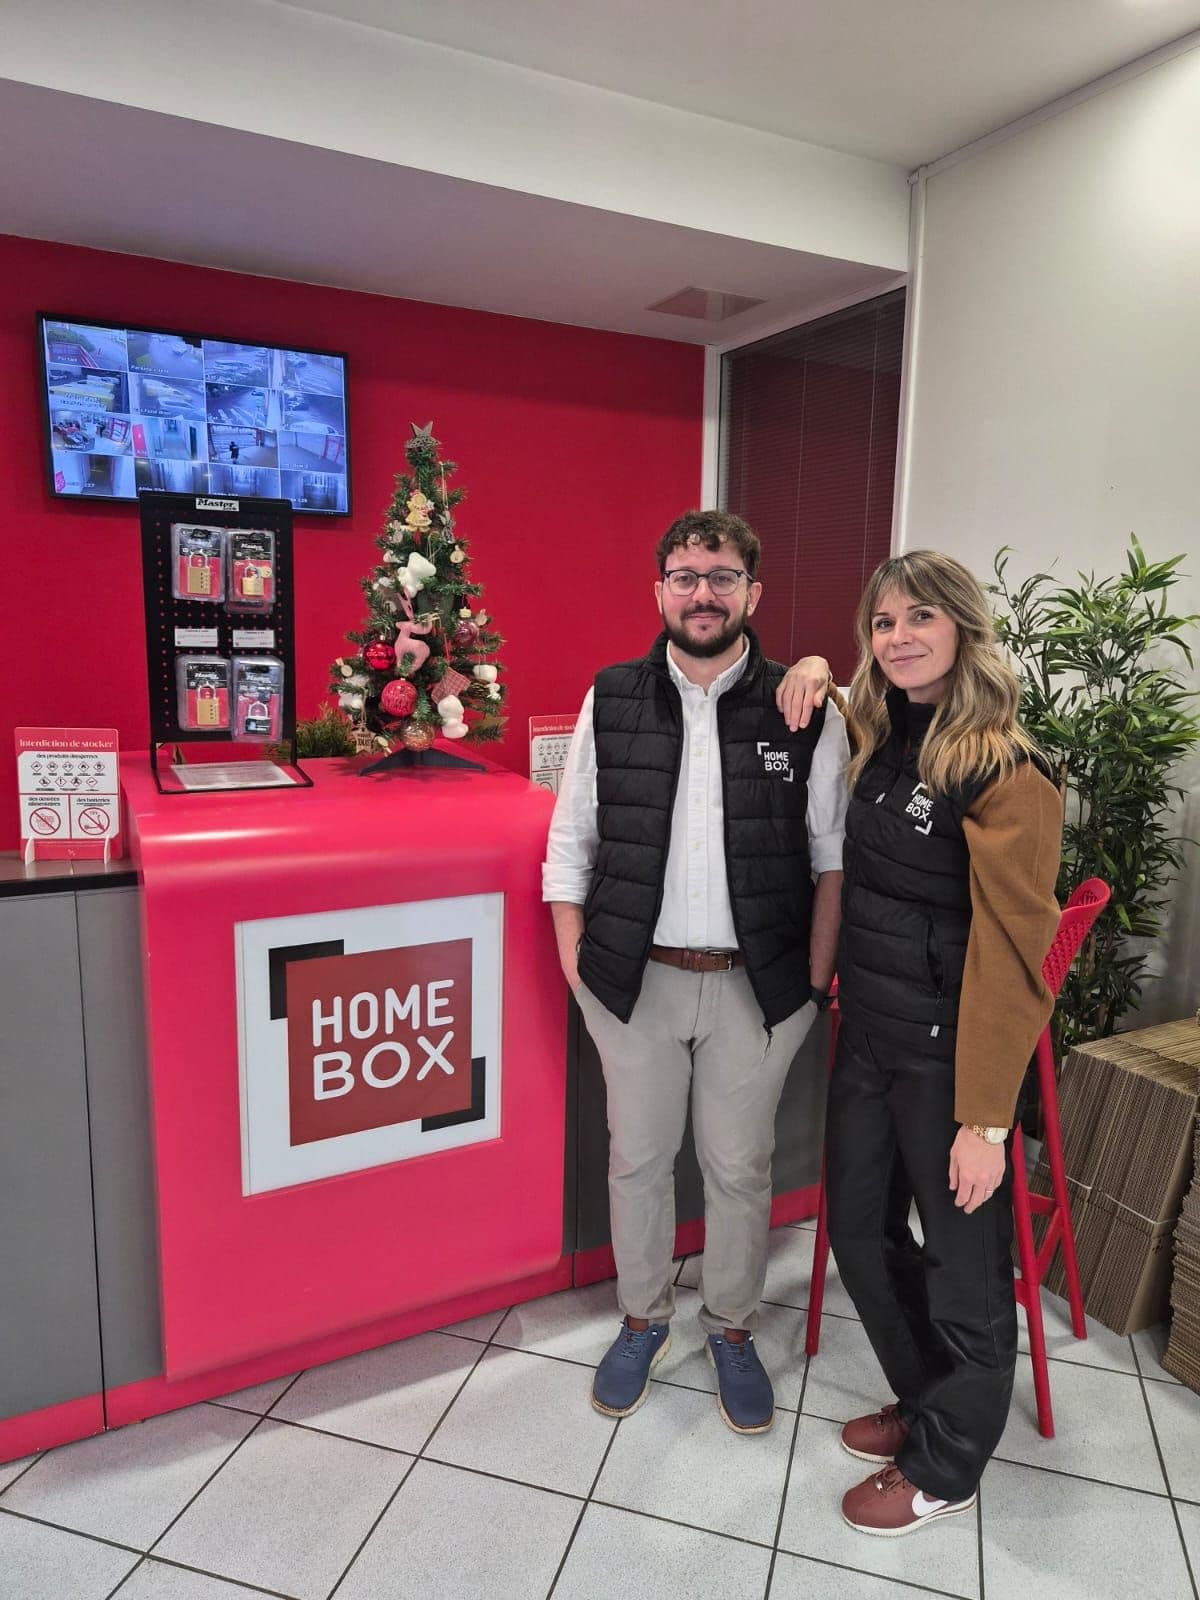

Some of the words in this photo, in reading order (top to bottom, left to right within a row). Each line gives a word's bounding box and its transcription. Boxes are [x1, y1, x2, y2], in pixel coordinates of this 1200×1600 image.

[197, 499, 234, 508] Master
[20, 739, 68, 748] Interdiction
[82, 740, 113, 748] stocker
[764, 751, 789, 761] HOME
[765, 760, 789, 772] BOX
[911, 793, 934, 812] HOME
[905, 802, 930, 823] BOX
[312, 979, 455, 1047] HOME
[313, 1030, 455, 1101] BOX
